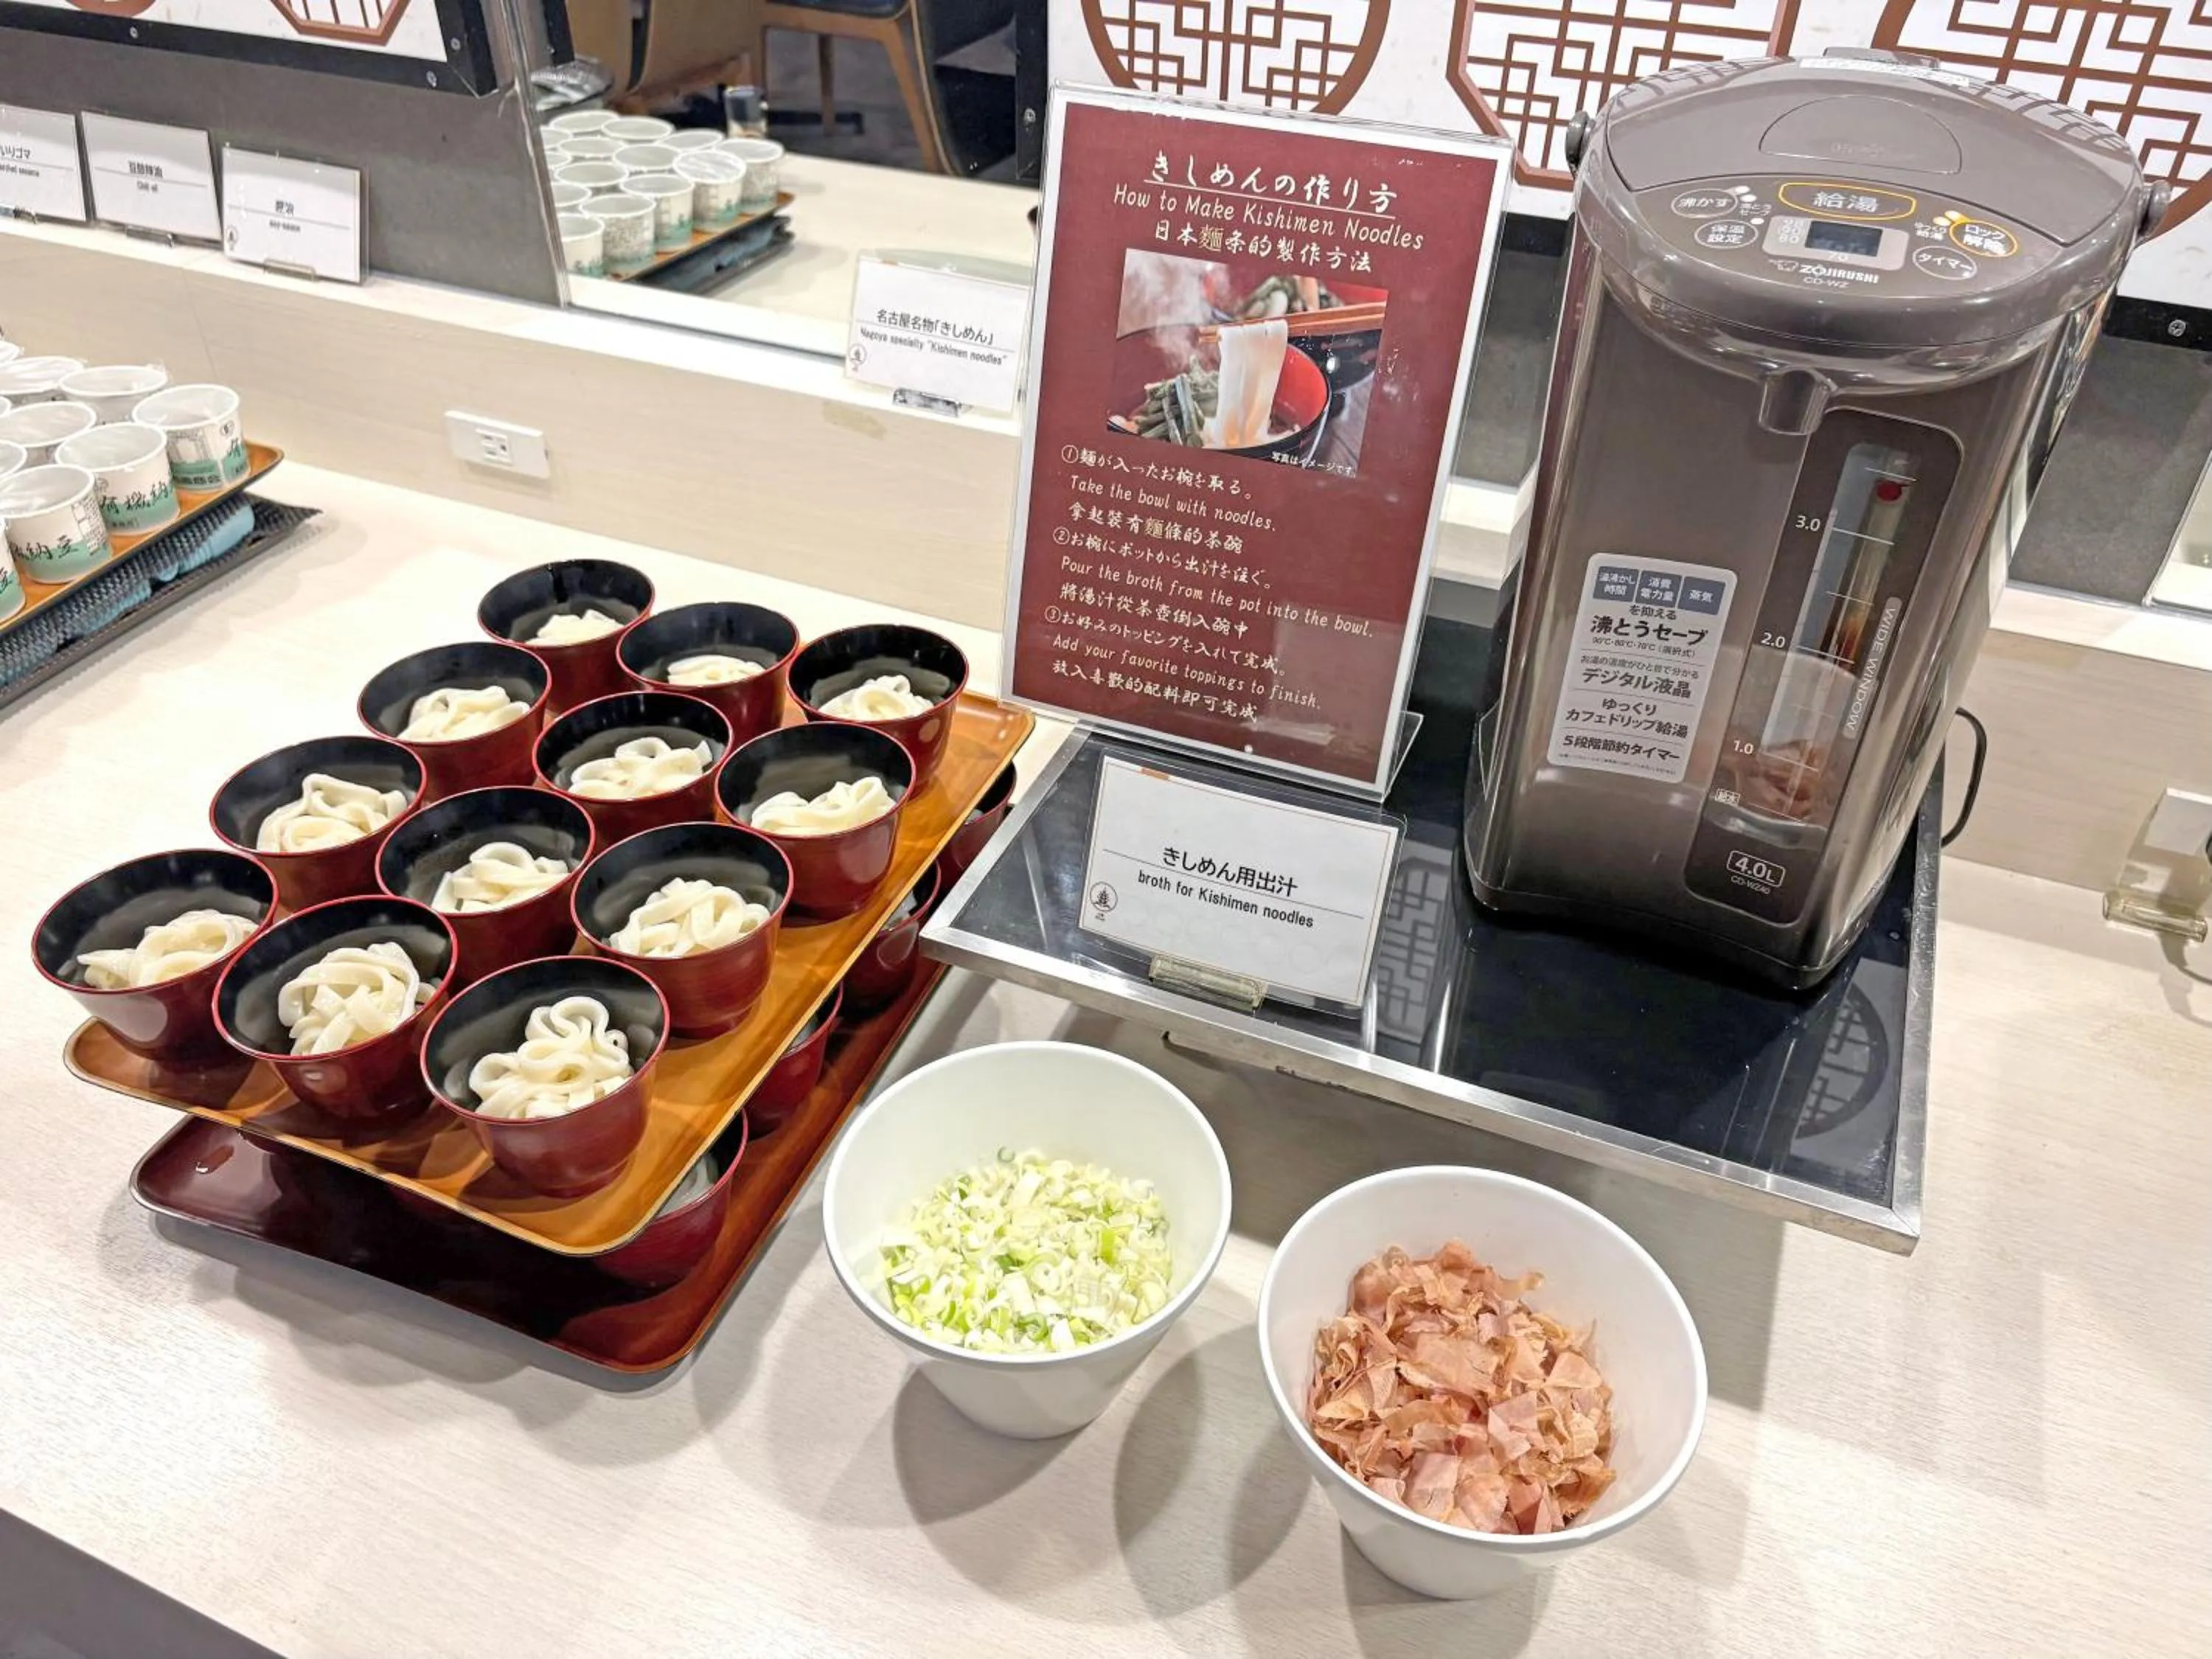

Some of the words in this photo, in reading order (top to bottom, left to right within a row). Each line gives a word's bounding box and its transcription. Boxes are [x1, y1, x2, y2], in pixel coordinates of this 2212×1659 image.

[1152, 150, 1398, 213] きしめんの作り方
[1114, 183, 1150, 209] How
[1160, 189, 1178, 212] to
[1184, 194, 1234, 220] Make
[1243, 201, 1335, 236] Kishimen
[1344, 217, 1424, 250] Noodles
[1812, 190, 1879, 214] 給湯
[1964, 223, 2006, 240] ロック
[1918, 253, 1973, 271] タイマー
[876, 308, 994, 346] 名古屋名物「きしめん」
[1071, 474, 1104, 495] Take
[1110, 483, 1132, 501] the
[1138, 488, 1171, 509] bowl
[1176, 498, 1207, 517] with
[1214, 508, 1276, 532] noodles.
[1795, 515, 1821, 532] 3.0
[1061, 555, 1093, 575] Pour
[1099, 563, 1121, 582] the
[1126, 569, 1163, 592] broth
[1169, 580, 1203, 601] from
[1210, 588, 1234, 607] the
[1238, 597, 1262, 613] pot
[1267, 601, 1298, 621] into
[1304, 608, 1328, 627] the
[1334, 614, 1373, 639] bowl.
[1629, 604, 1677, 621] を抑える
[1590, 614, 1709, 646] 沸とうセーブ
[1760, 632, 1786, 649] 2.0
[1871, 607, 1897, 653] WIDE
[1053, 633, 1079, 652] Add
[1085, 644, 1116, 660] your
[1120, 649, 1178, 675] favorite
[1183, 663, 1245, 692] toppings
[1251, 678, 1265, 695] to
[1269, 684, 1321, 711] finish.
[1581, 655, 1700, 679] お湯の温度がひと目で分かる
[1582, 667, 1692, 699] デジタル液晶
[1845, 656, 1879, 731] WINDOW
[1602, 698, 1657, 716] ゆっくり
[1565, 709, 1688, 739] カフェドリップ給湯
[1562, 734, 1681, 761] 5段階節約タイマー
[1733, 739, 1755, 755] 1.0
[1162, 846, 1298, 898] きしめん用出汁
[1734, 857, 1775, 883] 4.0L
[1138, 869, 1171, 891] broth
[1176, 881, 1194, 897] for
[1198, 887, 1259, 915] Kishimen
[1262, 905, 1314, 928] noodles
